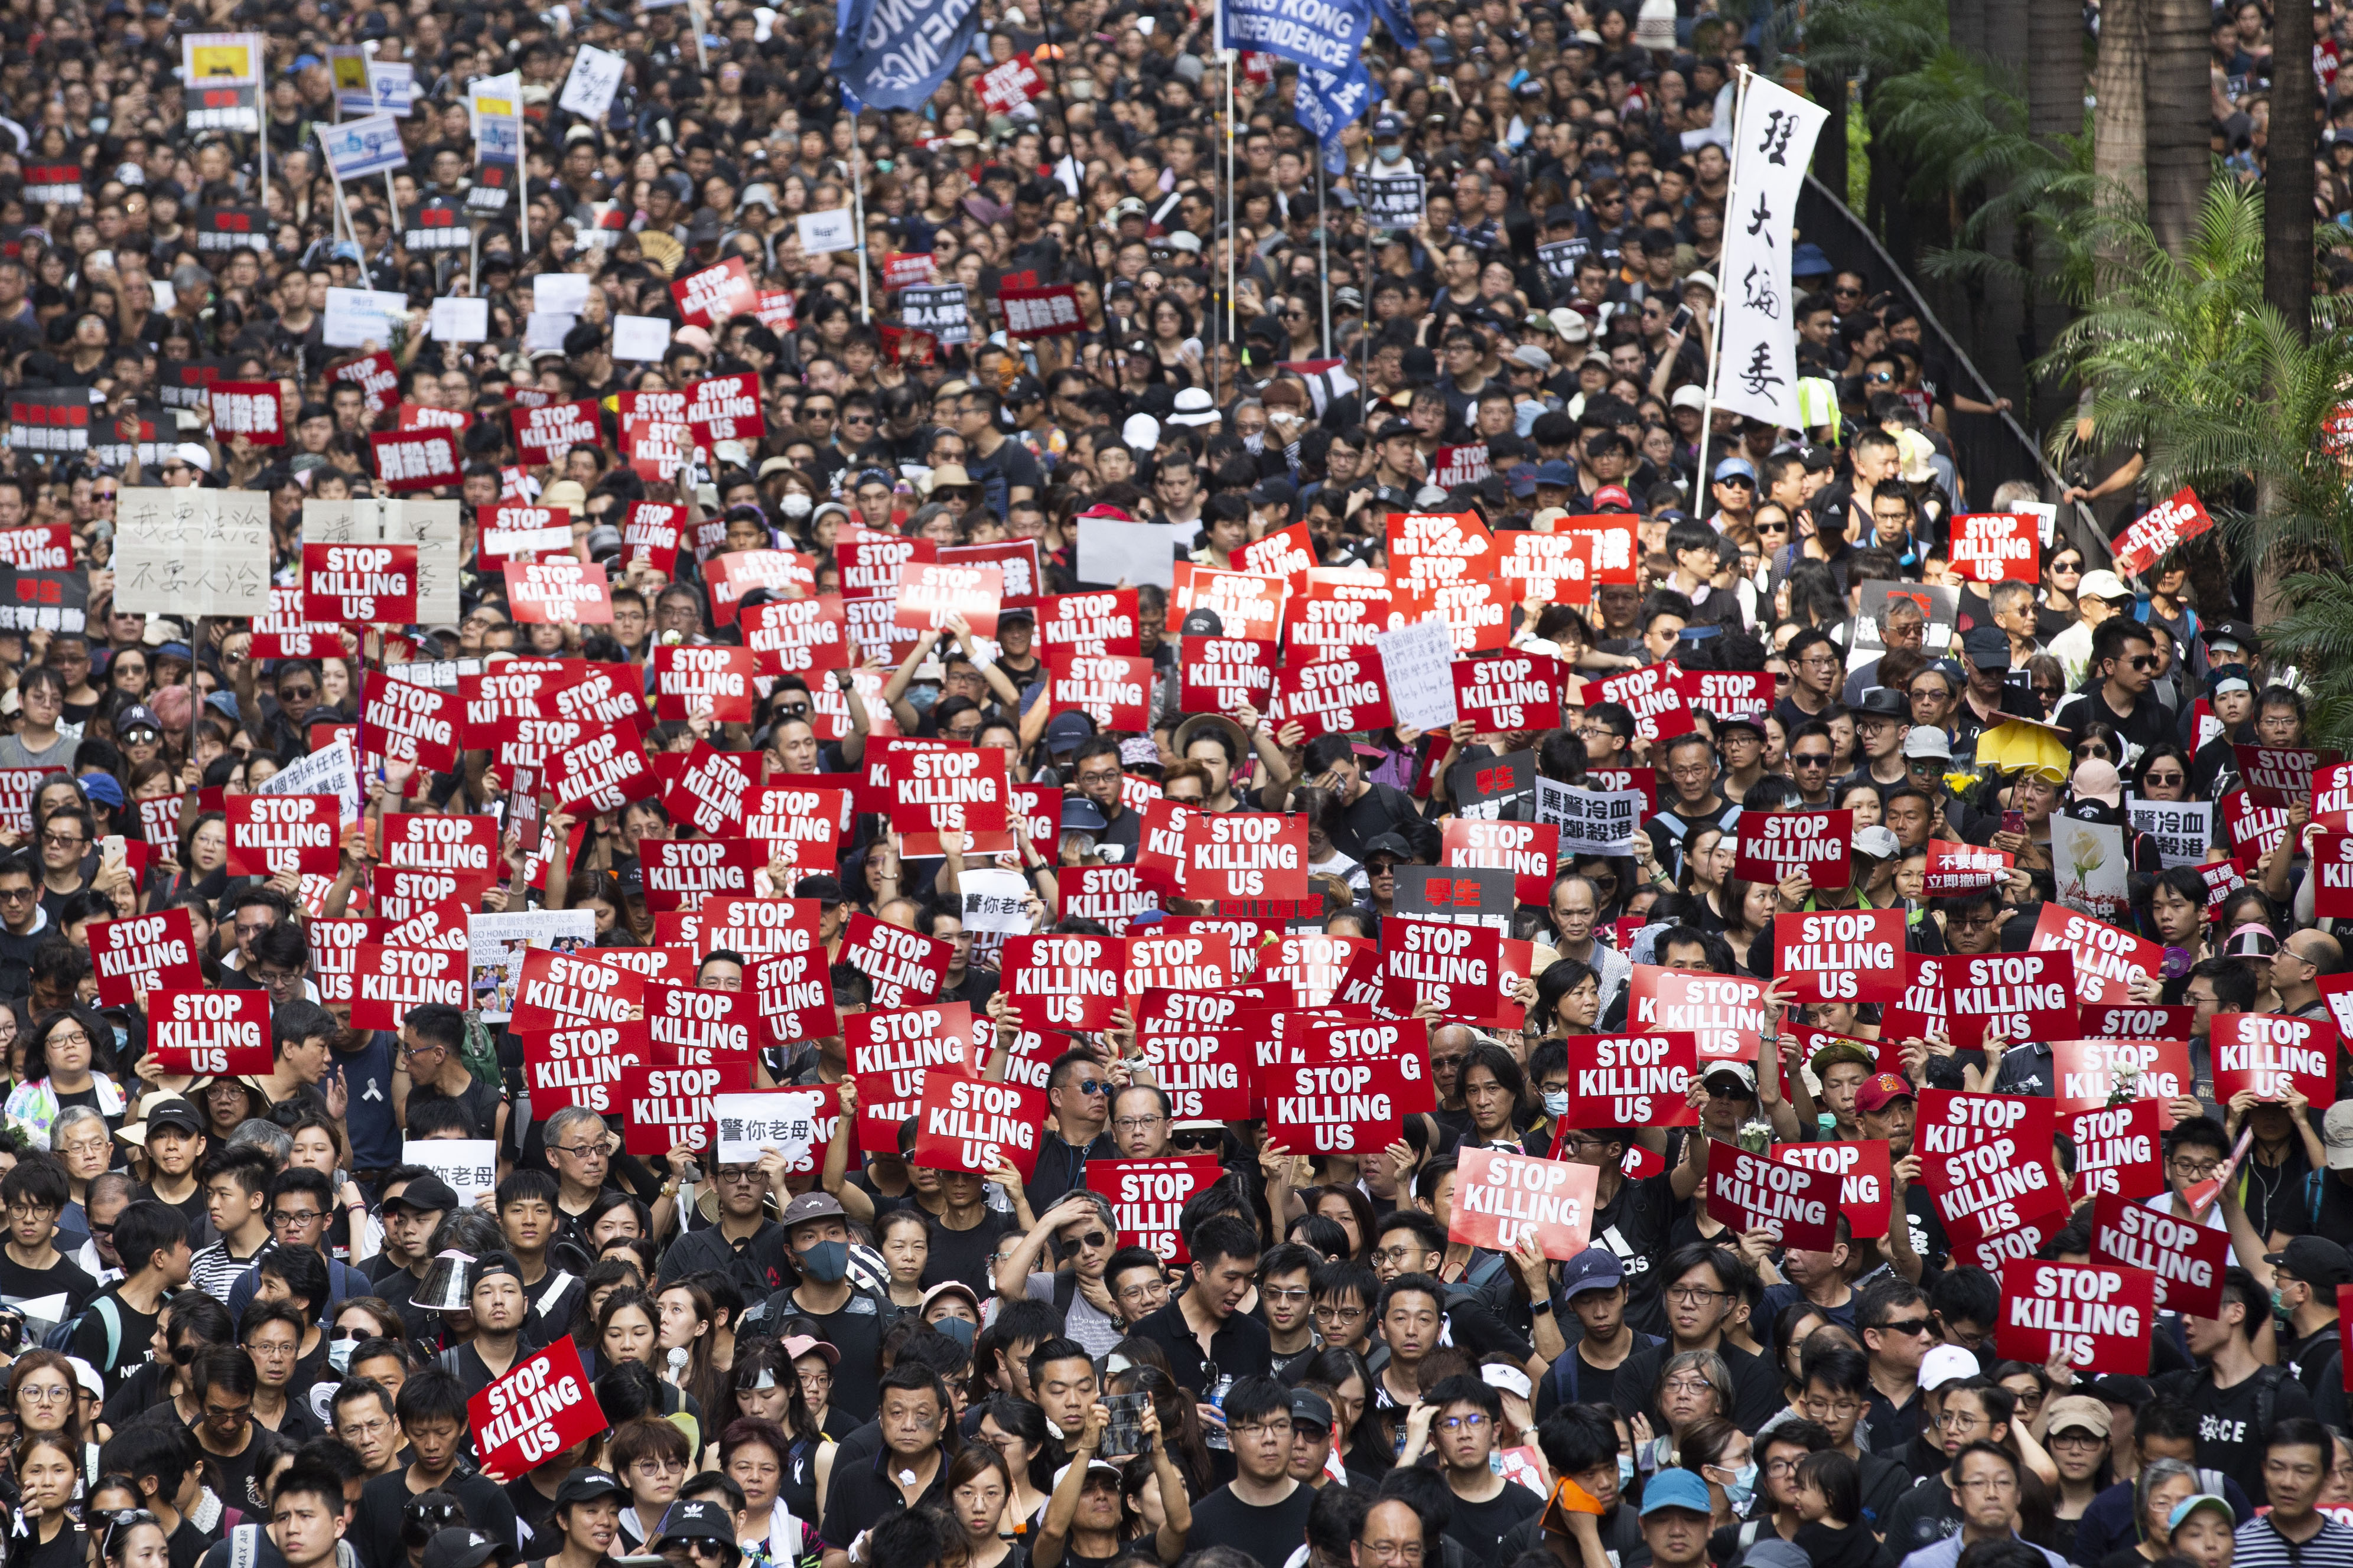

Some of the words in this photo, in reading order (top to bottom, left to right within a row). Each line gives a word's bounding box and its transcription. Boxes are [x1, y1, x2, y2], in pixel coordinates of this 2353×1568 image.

[697, 378, 743, 402] STOP
[530, 406, 580, 428] STOP
[688, 395, 756, 422] KILLING
[520, 421, 595, 447] KILLING
[710, 419, 735, 439] US
[133, 501, 262, 545] 我要法治
[634, 504, 673, 524] STOP
[625, 523, 676, 547] KILLING
[1965, 517, 2017, 538] STOP
[327, 547, 392, 572] STOP
[743, 552, 796, 568] STOP
[1954, 538, 2030, 560] KILLING
[131, 560, 261, 597] 不要人治
[525, 566, 582, 585] STOP
[735, 566, 812, 582] KILLING
[922, 567, 981, 587] STOP
[1976, 559, 2003, 580] US
[312, 573, 406, 596] KILLING
[514, 582, 601, 602] KILLING
[905, 584, 991, 611] KILLING
[1434, 584, 1490, 608] STOP
[343, 596, 375, 620] US
[545, 601, 576, 620] US
[762, 601, 820, 627] STOP
[1059, 595, 1116, 620] STOP
[1307, 600, 1366, 622] STOP
[1422, 603, 1503, 627] KILLING
[750, 621, 838, 650] KILLING
[1046, 615, 1132, 643] KILLING
[1292, 622, 1380, 646] KILLING
[780, 647, 812, 671] US
[1204, 640, 1260, 664] STOP
[1189, 663, 1270, 688] KILLING
[1300, 661, 1359, 690] STOP
[1474, 659, 1531, 684] STOP
[383, 682, 442, 709] STOP
[1218, 687, 1248, 708] US
[1288, 681, 1380, 713] KILLING
[1462, 680, 1550, 709] KILLING
[366, 701, 451, 746] KILLING
[1321, 710, 1354, 732] US
[1493, 705, 1524, 728] US
[389, 732, 416, 759] US
[564, 734, 616, 774] STOP
[557, 751, 642, 803] KILLING
[913, 753, 979, 778] STOP
[899, 778, 995, 803] KILLING
[1477, 766, 1515, 794] 學生
[250, 798, 315, 823] STOP
[590, 785, 625, 811] US
[1542, 787, 1632, 819] 黑警冷血
[930, 804, 962, 827] US
[2127, 810, 2204, 833] 警冷血
[236, 823, 330, 847] KILLING
[407, 818, 472, 843] STOP
[1212, 817, 1281, 843] STOP
[267, 848, 300, 871] US
[391, 842, 487, 868] KILLING
[662, 843, 725, 866] STOP
[1195, 844, 1297, 869] KILLING
[1939, 854, 2003, 869] 不要暫緩
[650, 866, 744, 890] KILLING
[1228, 871, 1263, 895] US
[1927, 873, 1991, 889] 立即撤回
[1425, 878, 1480, 907] 學生
[727, 902, 794, 927] STOP
[311, 922, 367, 948] STOP
[711, 928, 809, 953] KILLING
[1802, 915, 1875, 943] STOP
[380, 950, 448, 977] STOP
[1031, 940, 1101, 966] STOP
[1785, 943, 1893, 971] KILLING
[1016, 969, 1116, 996] KILLING
[1970, 957, 2043, 986] STOP
[321, 974, 353, 999] US
[362, 974, 462, 1005] KILLING
[1820, 972, 1857, 998] US
[1954, 983, 2065, 1013] KILLING
[173, 995, 242, 1021] STOP
[1046, 996, 1084, 1023] US
[158, 1022, 260, 1047] KILLING
[871, 1010, 941, 1042] STOP
[191, 1048, 227, 1072] US
[856, 1038, 964, 1073] KILLING
[1597, 1038, 1669, 1067] STOP
[893, 1069, 926, 1097] US
[1296, 1066, 1371, 1095] STOP
[1580, 1066, 1688, 1097] KILLING
[950, 1082, 1021, 1116] STOP
[1278, 1094, 1391, 1123] KILLING
[1615, 1096, 1652, 1123] US
[721, 1119, 809, 1141] 警你老母
[929, 1107, 1033, 1150] KILLING
[1316, 1124, 1354, 1150] US
[961, 1140, 1001, 1169] US
[425, 1166, 493, 1186] 你老母
[1121, 1173, 1194, 1202] STOP
[2120, 1207, 2200, 1247] STOP
[1139, 1232, 1176, 1261] US
[2100, 1225, 2212, 1287] KILLING
[2035, 1267, 2121, 1302] STOP
[2012, 1297, 2139, 1337] KILLING
[2050, 1332, 2094, 1365] US
[489, 1357, 549, 1413] STOP
[481, 1377, 582, 1453] KILLING
[518, 1422, 559, 1461] US
